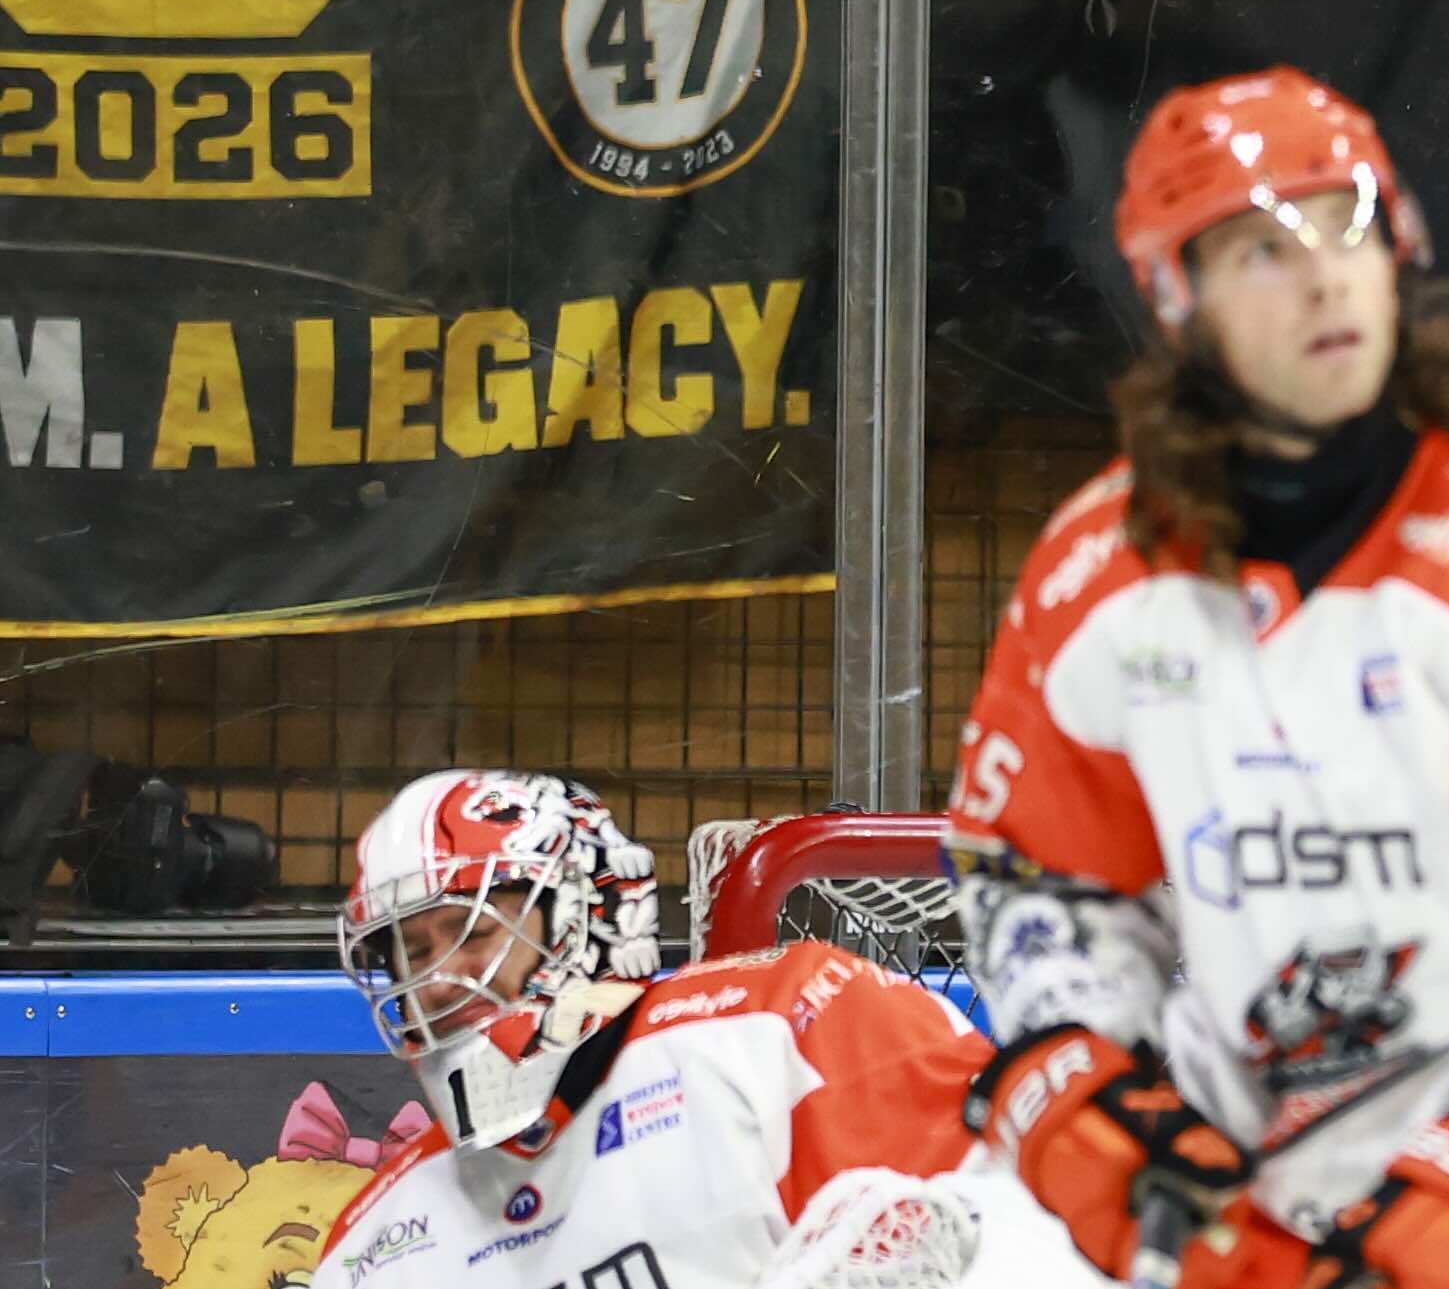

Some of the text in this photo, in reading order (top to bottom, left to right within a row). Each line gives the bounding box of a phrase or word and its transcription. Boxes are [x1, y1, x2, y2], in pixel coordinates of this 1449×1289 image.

[0, 68, 354, 182] 2026
[588, 141, 650, 183] 1994
[152, 321, 256, 470] A
[292, 279, 812, 467] LEGACY.
[1231, 810, 1426, 891] dsm
